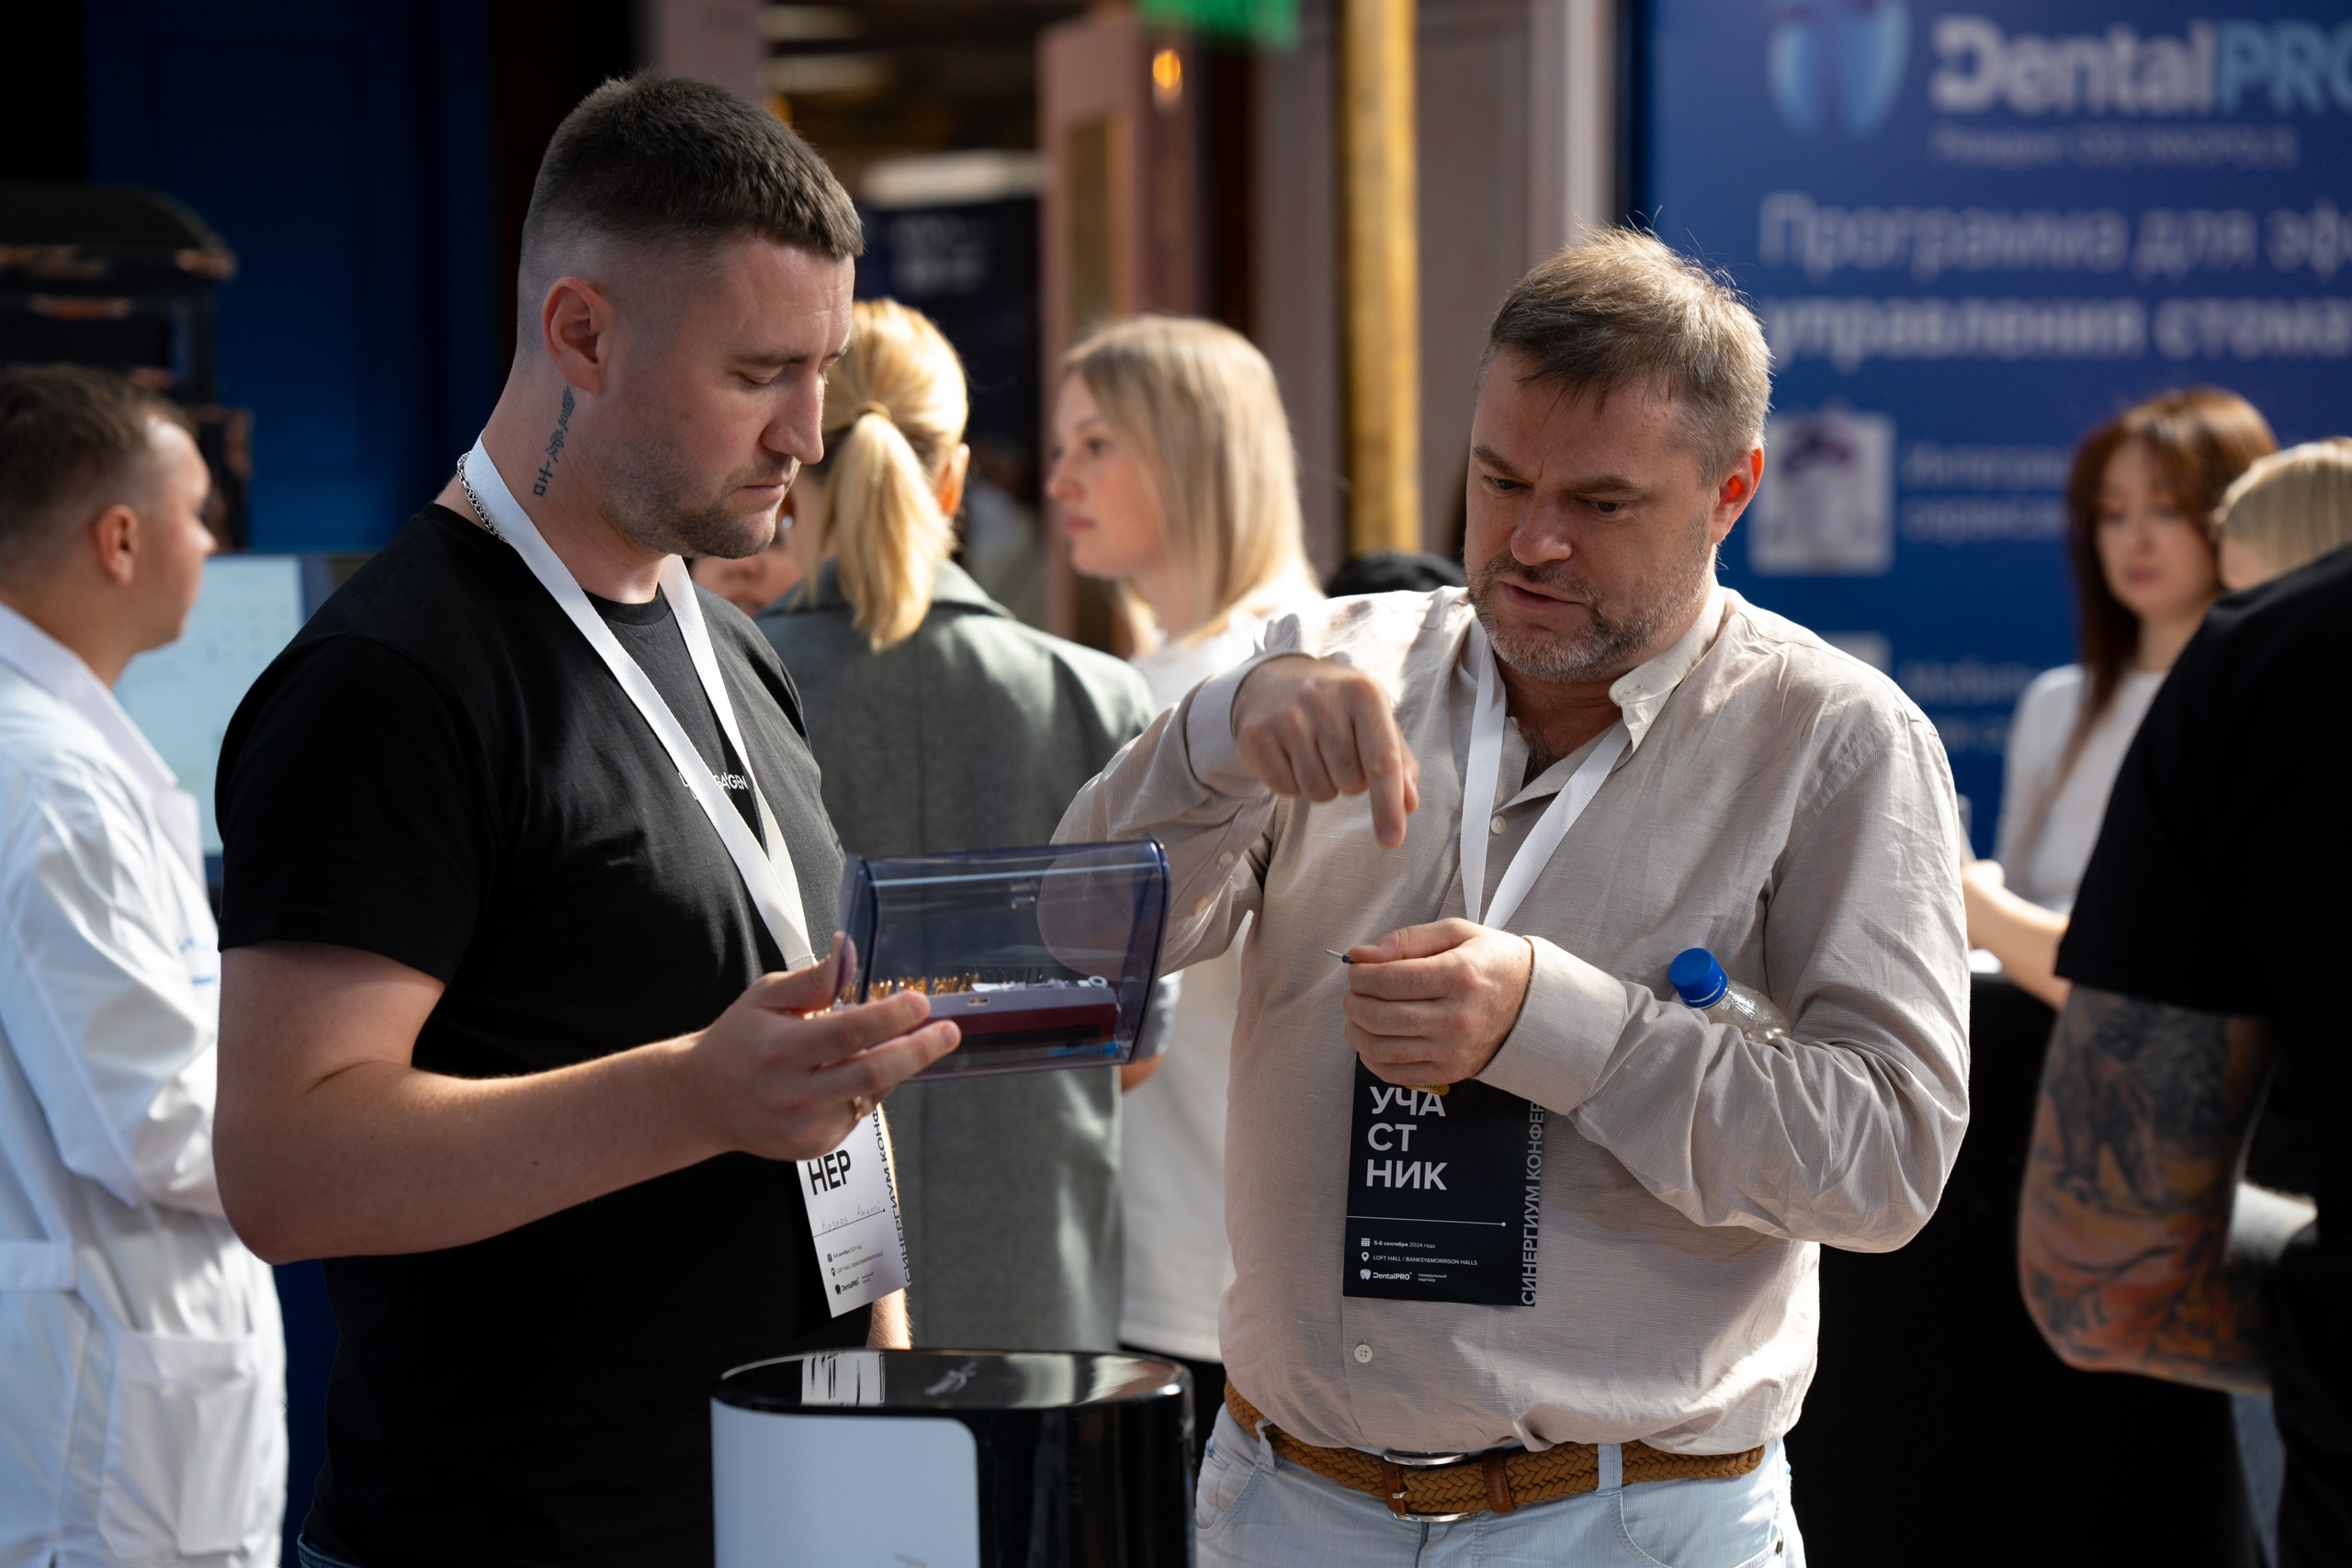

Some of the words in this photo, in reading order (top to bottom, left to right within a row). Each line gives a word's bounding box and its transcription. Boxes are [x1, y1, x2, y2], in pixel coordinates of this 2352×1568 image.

[1759, 193, 2128, 282] Программа
[2132, 208, 2257, 282] для
[2264, 195, 2352, 283] эф
[1765, 296, 2147, 372] управления
[1369, 1086, 1446, 1117] УЧА
[1367, 1122, 1418, 1152] СТ
[807, 1149, 851, 1196] НЕР
[1366, 1158, 1448, 1190] НИК
[1521, 1186, 1541, 1305] СИНЕРГИУМ
[1373, 1272, 1410, 1280] DentalPRO
